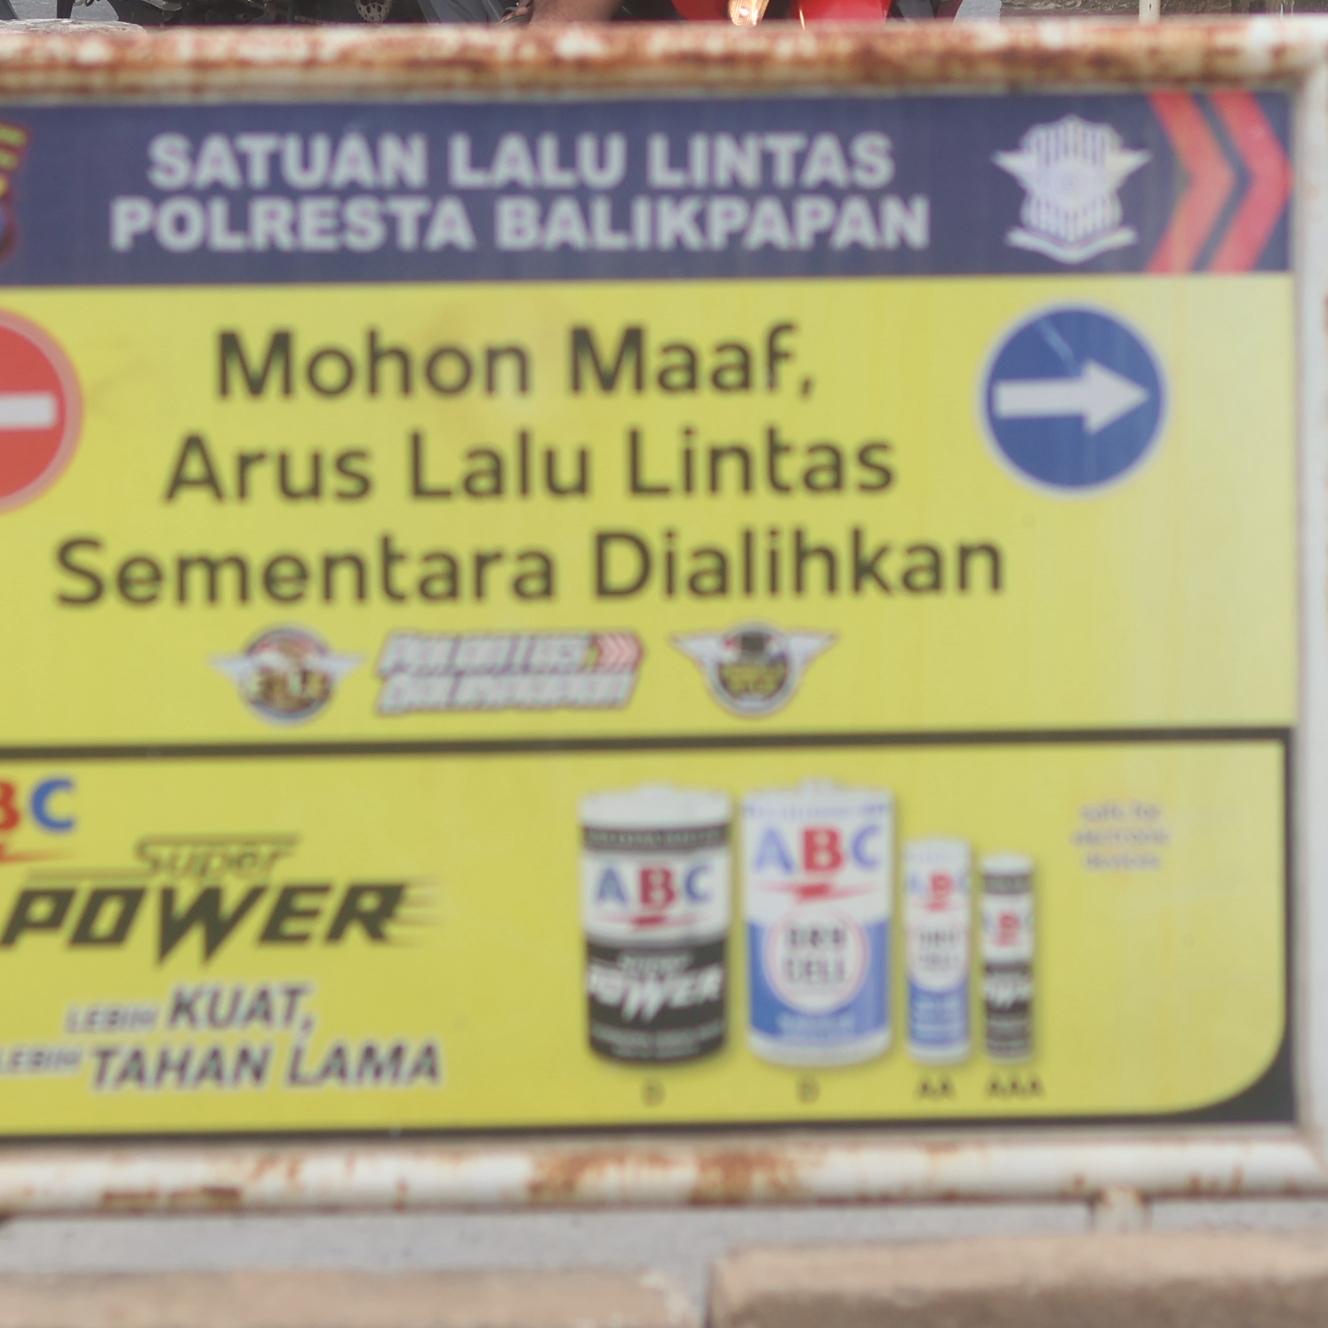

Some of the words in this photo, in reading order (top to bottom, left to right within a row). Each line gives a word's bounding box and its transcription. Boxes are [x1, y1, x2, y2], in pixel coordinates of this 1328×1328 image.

[148, 135, 425, 189] SATUAN
[450, 133, 627, 188] LALU
[649, 131, 895, 188] LINTAS
[111, 196, 476, 251] POLRESTA
[496, 195, 930, 250] BALIKPAPAN
[215, 327, 532, 400] Mohon
[569, 324, 815, 401] Maaf,
[162, 433, 374, 505] Arus
[408, 428, 593, 501] Lalu
[628, 425, 897, 498] Lintas
[54, 536, 556, 608] Sementara
[593, 528, 1005, 601] Dialihkan
[132, 834, 301, 878] Super
[753, 824, 883, 873] ABC
[593, 866, 715, 909] ABC
[166, 982, 314, 1037] KUAT,
[91, 1044, 273, 1093] TAHAN
[285, 1038, 443, 1089] LAMA
